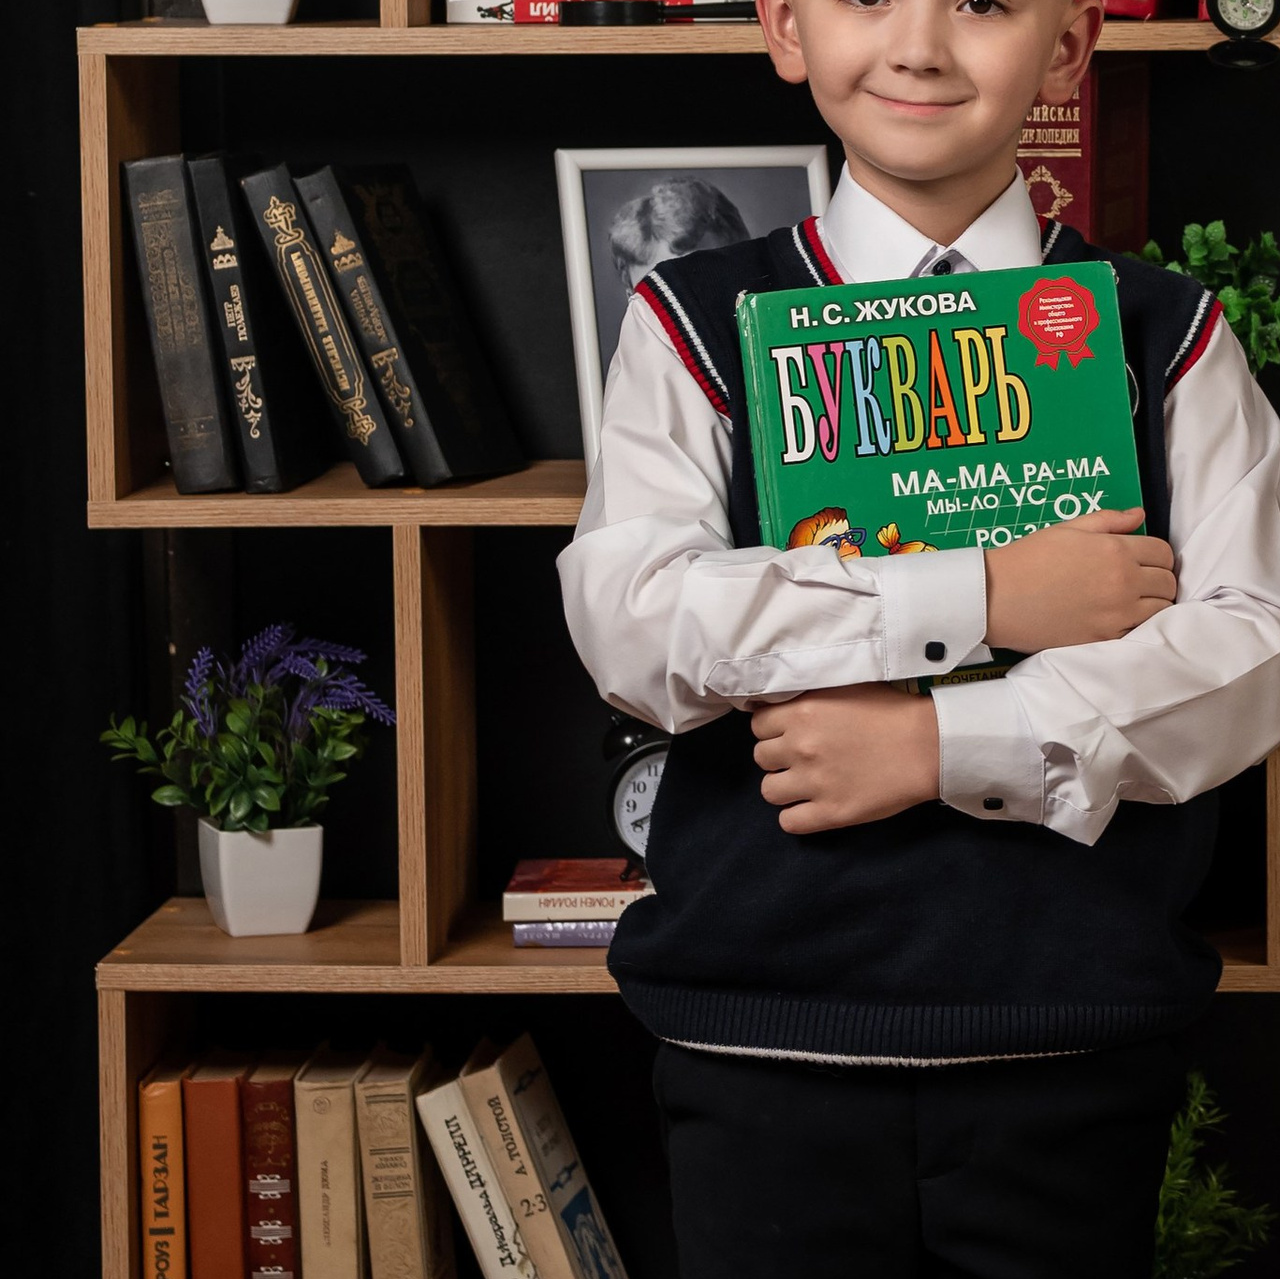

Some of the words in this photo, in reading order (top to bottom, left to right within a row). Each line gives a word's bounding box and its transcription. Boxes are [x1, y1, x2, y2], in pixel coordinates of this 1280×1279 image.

[1026, 105, 1080, 122] ИЙСКАЯ
[1019, 128, 1080, 145] ИКЛОПЕДИЯ
[290, 251, 329, 333] ВЛАДИМИРОВИЧ
[790, 307, 818, 329] Н.
[823, 304, 850, 326] С.
[853, 290, 978, 322] ЖУКОВА
[322, 335, 351, 391] МСТИСЛАВ
[770, 325, 1033, 465] БУКВАРЬ
[891, 462, 1013, 498] МА-МА
[1023, 455, 1111, 482] РА-МА
[926, 493, 1000, 516] МЫ-ЛО
[1009, 484, 1047, 507] УС
[1054, 490, 1106, 521] ОХ
[975, 523, 1052, 549] РО-З
[632, 781, 647, 794] 10
[647, 764, 659, 777] 11
[626, 800, 637, 813] 9
[538, 897, 578, 908] РОЛЛАН
[580, 896, 616, 908] РОМЕН
[487, 1095, 521, 1159] ТОЛСТОЙ
[445, 1114, 485, 1190] ДАРРЕЛЛ
[514, 1156, 529, 1176] А.
[150, 1134, 172, 1221] ТАРЗАН
[480, 1189, 517, 1268] Джеральд
